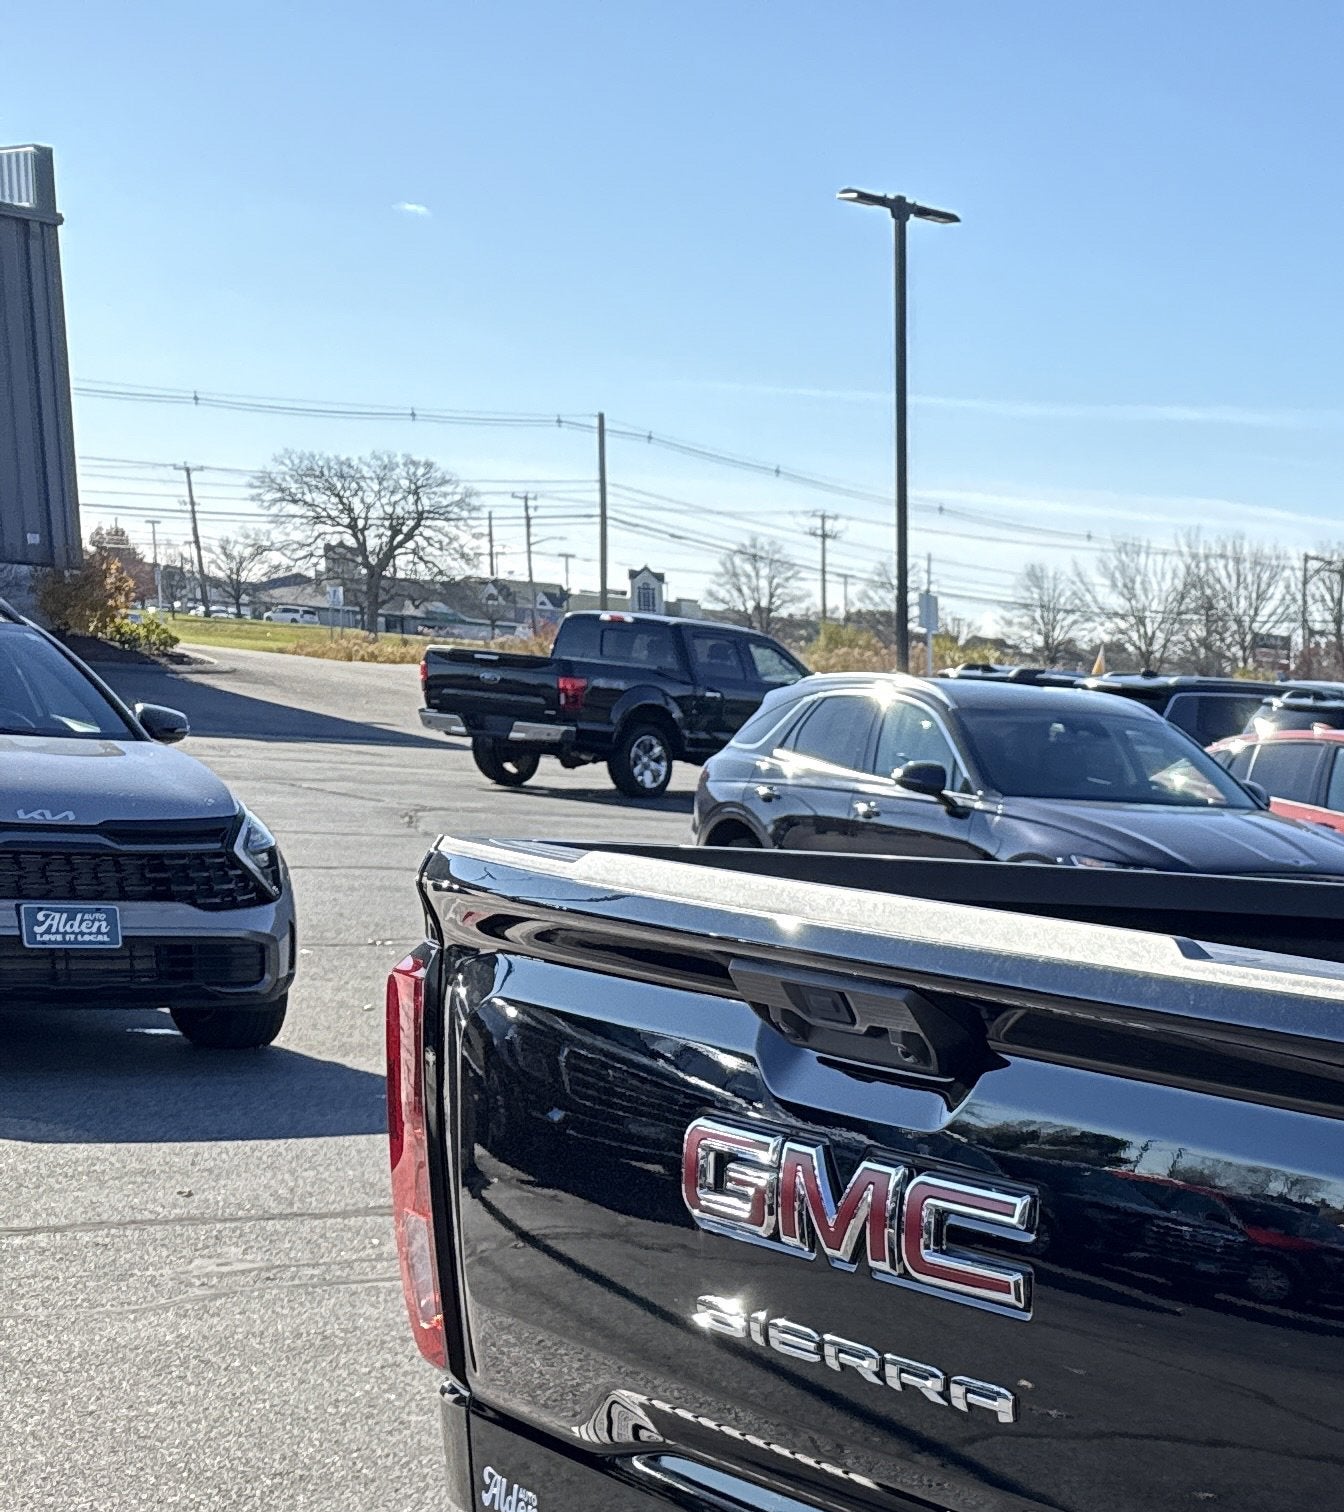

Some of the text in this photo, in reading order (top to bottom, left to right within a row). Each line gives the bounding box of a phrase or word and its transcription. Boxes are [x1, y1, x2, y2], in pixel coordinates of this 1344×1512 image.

[33, 910, 110, 933] Alden
[83, 913, 107, 921] AUTO
[36, 933, 111, 942] LOVE IT LOCAL
[682, 1115, 1038, 1321] GMC
[693, 1295, 1017, 1423] SIERRA
[519, 1487, 538, 1507] AUTO
